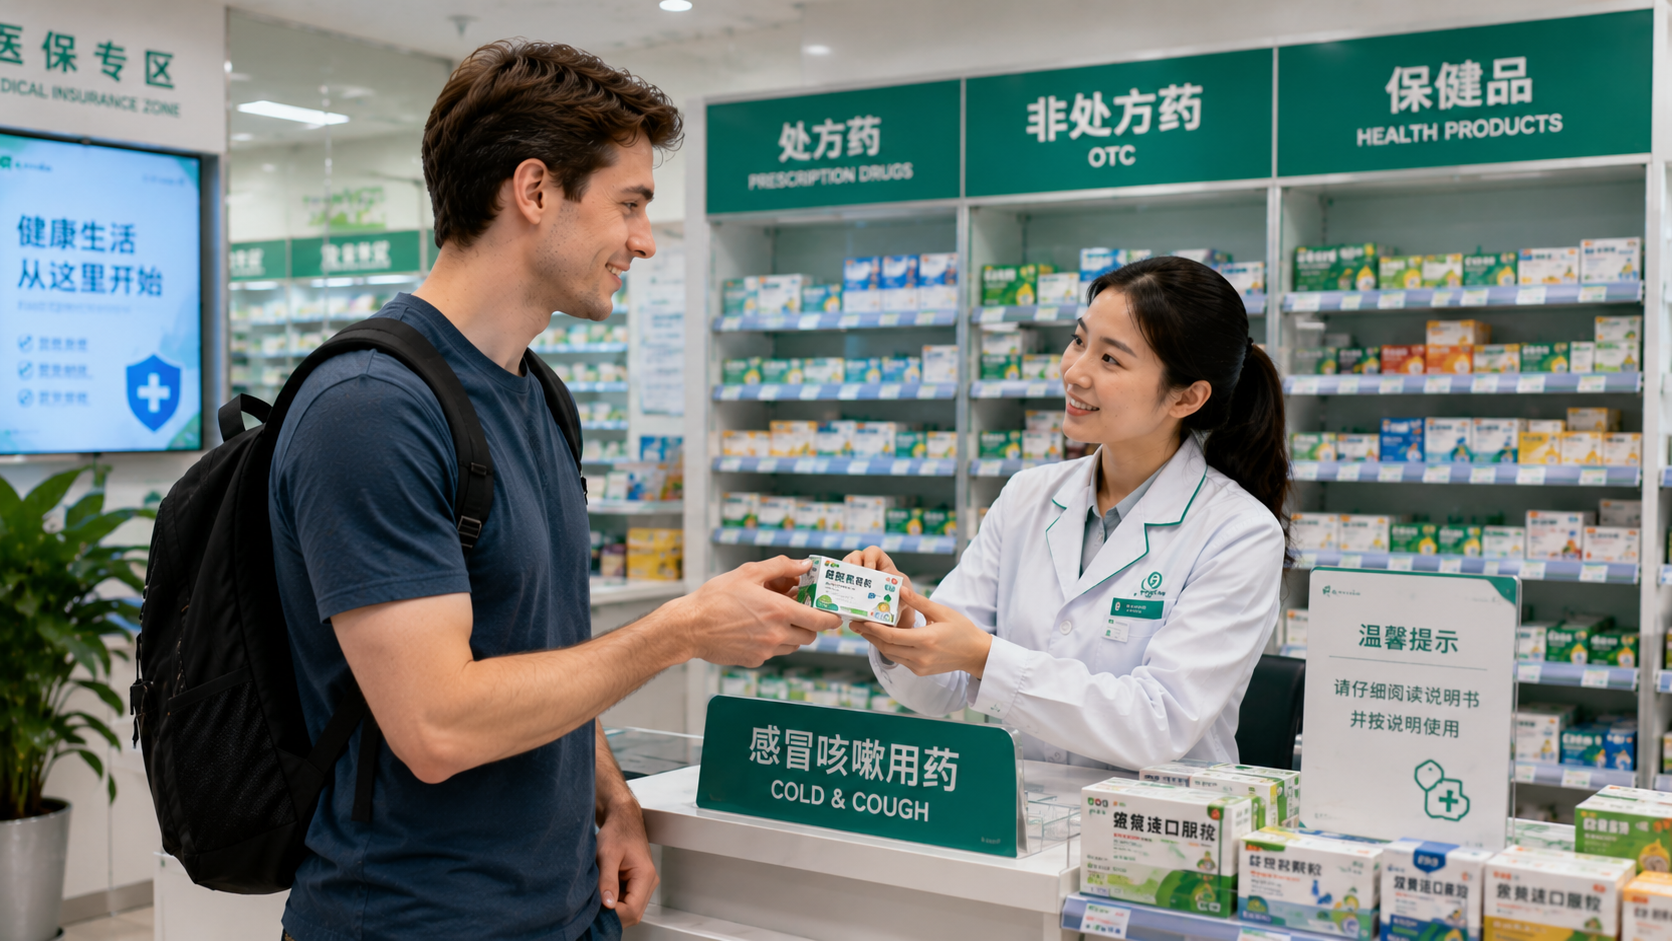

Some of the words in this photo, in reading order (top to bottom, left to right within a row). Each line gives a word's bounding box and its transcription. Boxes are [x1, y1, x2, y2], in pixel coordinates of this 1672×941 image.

[0, 23, 174, 89] 医保专区
[52, 85, 138, 112] INSURANCE
[142, 97, 181, 118] ZONE
[1385, 56, 1533, 114] 保健品
[1026, 83, 1203, 143] 非处方药
[1356, 123, 1439, 147] HEALTH
[1444, 113, 1564, 141] PRODUCTS
[778, 115, 882, 162] 处方药
[1088, 144, 1136, 168] OTC
[748, 166, 856, 191] PRESCRIPTION
[858, 162, 914, 183] DRUGS
[17, 214, 137, 255] 健康生活
[17, 258, 164, 297] 从这里开始
[1358, 623, 1459, 654] 温馨提示
[1333, 678, 1480, 708] 请仔细阅读说明书
[749, 724, 960, 793] 感冒咳嗽用药
[770, 779, 825, 806] COLD
[831, 788, 846, 809] &
[852, 791, 929, 822] COUGH
